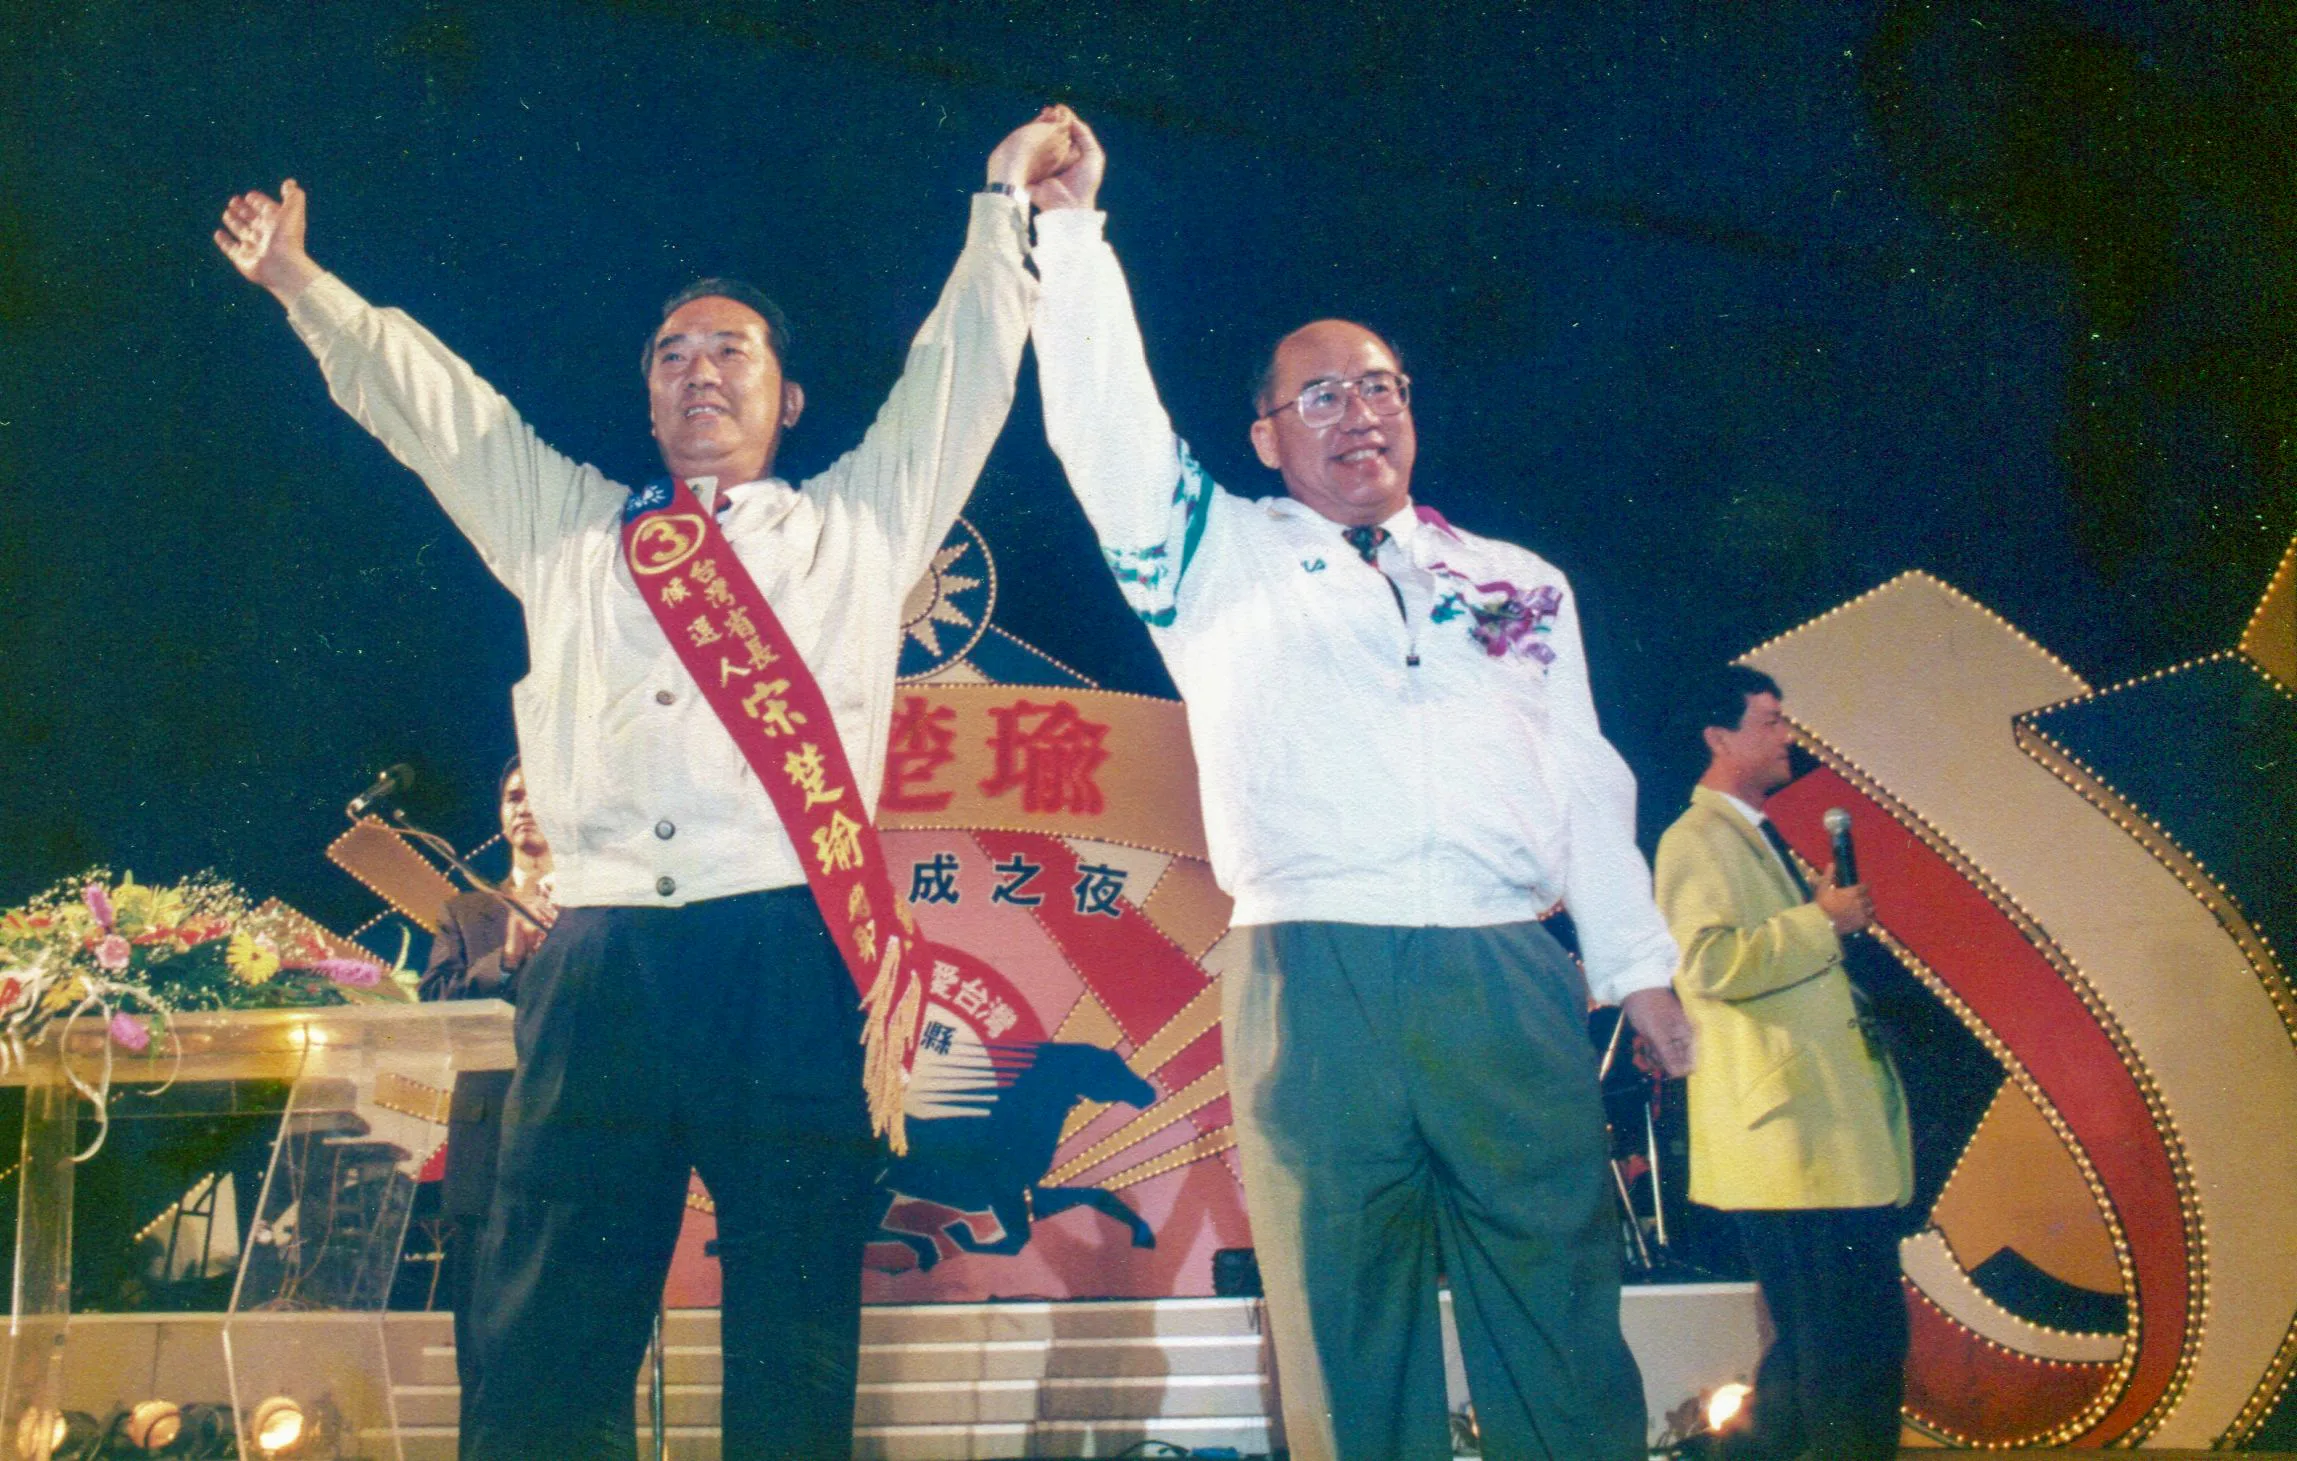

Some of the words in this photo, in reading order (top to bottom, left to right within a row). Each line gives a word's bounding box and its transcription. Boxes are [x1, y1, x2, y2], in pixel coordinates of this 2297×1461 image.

[641, 520, 690, 562] 3
[660, 576, 752, 689] 候選人
[689, 558, 781, 671] 台灣省長
[741, 678, 864, 876] 宋楚瑜
[907, 852, 1129, 917] 成之夜
